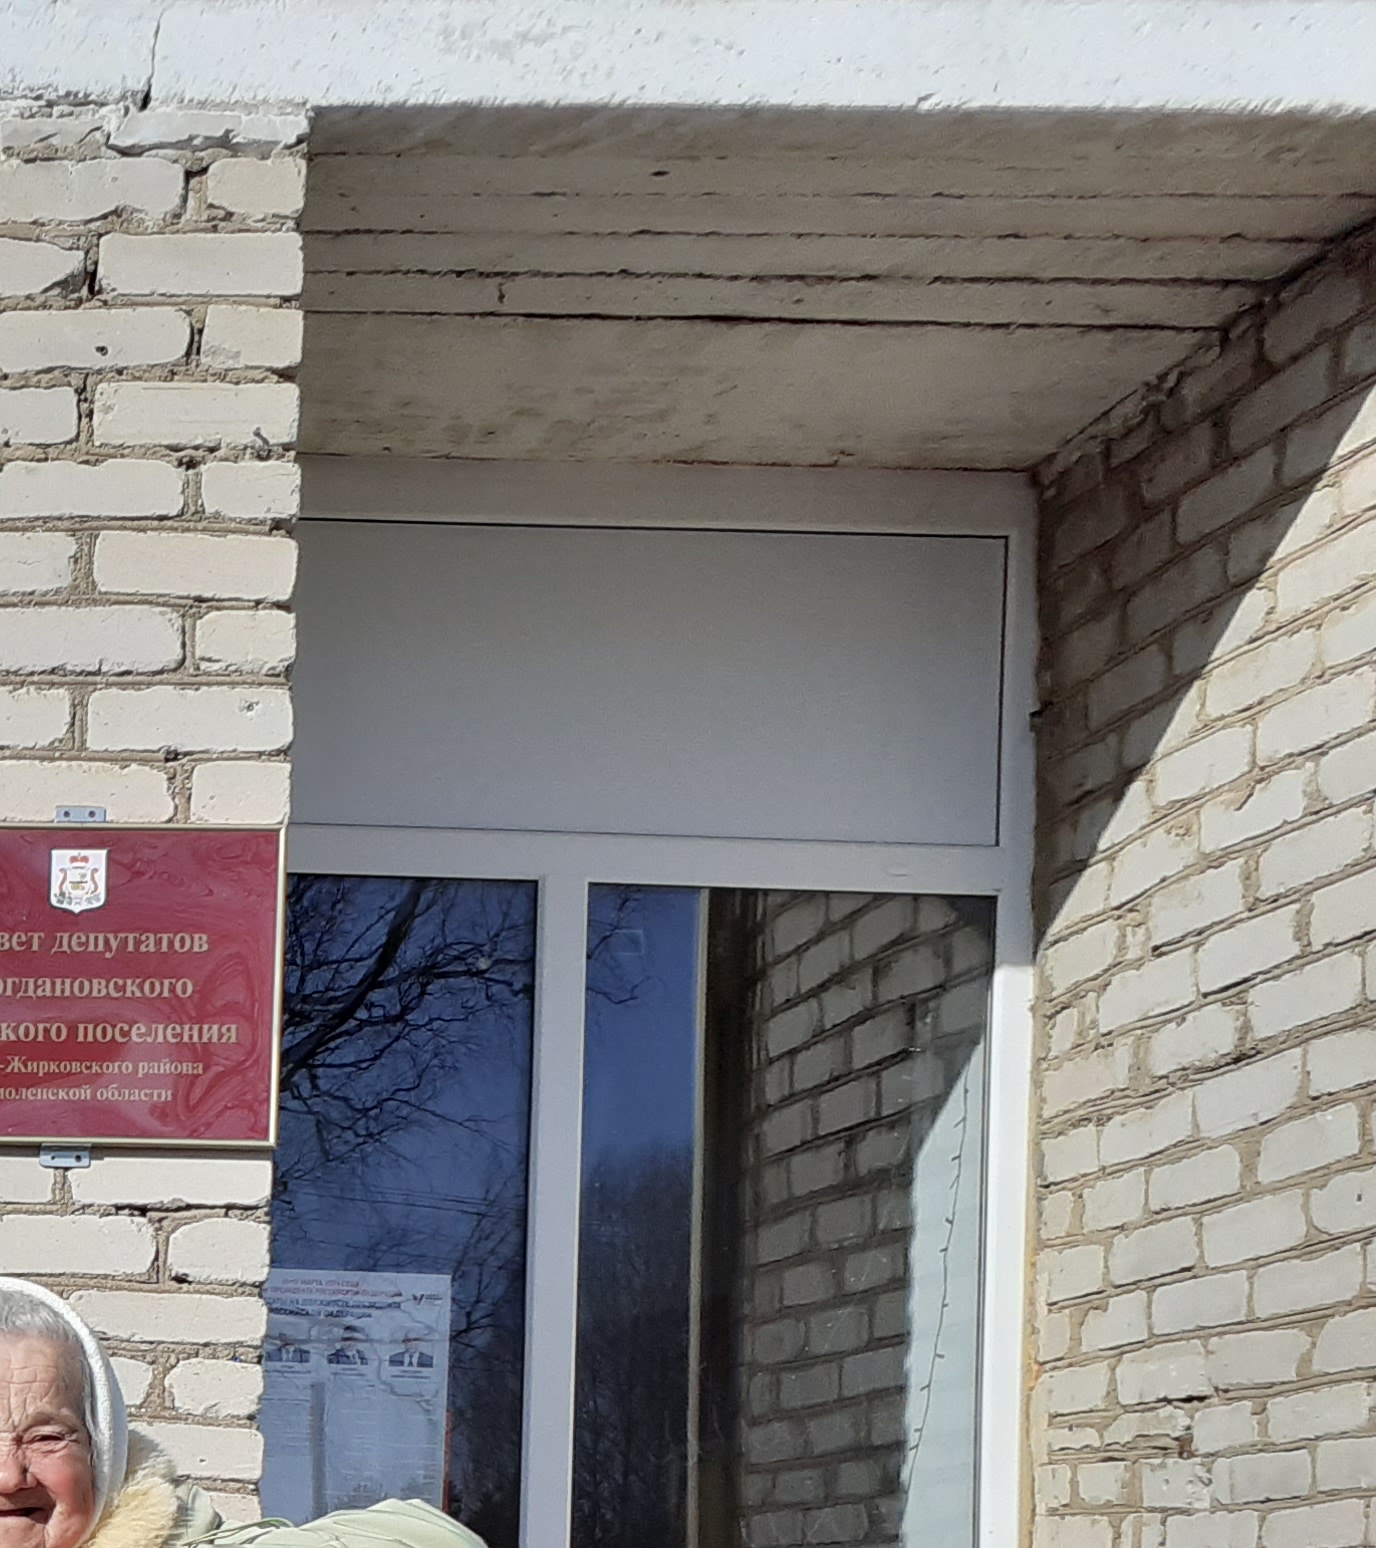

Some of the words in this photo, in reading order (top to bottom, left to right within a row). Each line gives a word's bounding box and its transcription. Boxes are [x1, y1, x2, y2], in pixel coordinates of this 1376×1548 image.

[51, 931, 210, 959] депутатов
[76, 1021, 239, 1044] поселения
[137, 1058, 204, 1077] района
[96, 1084, 173, 1102] области
